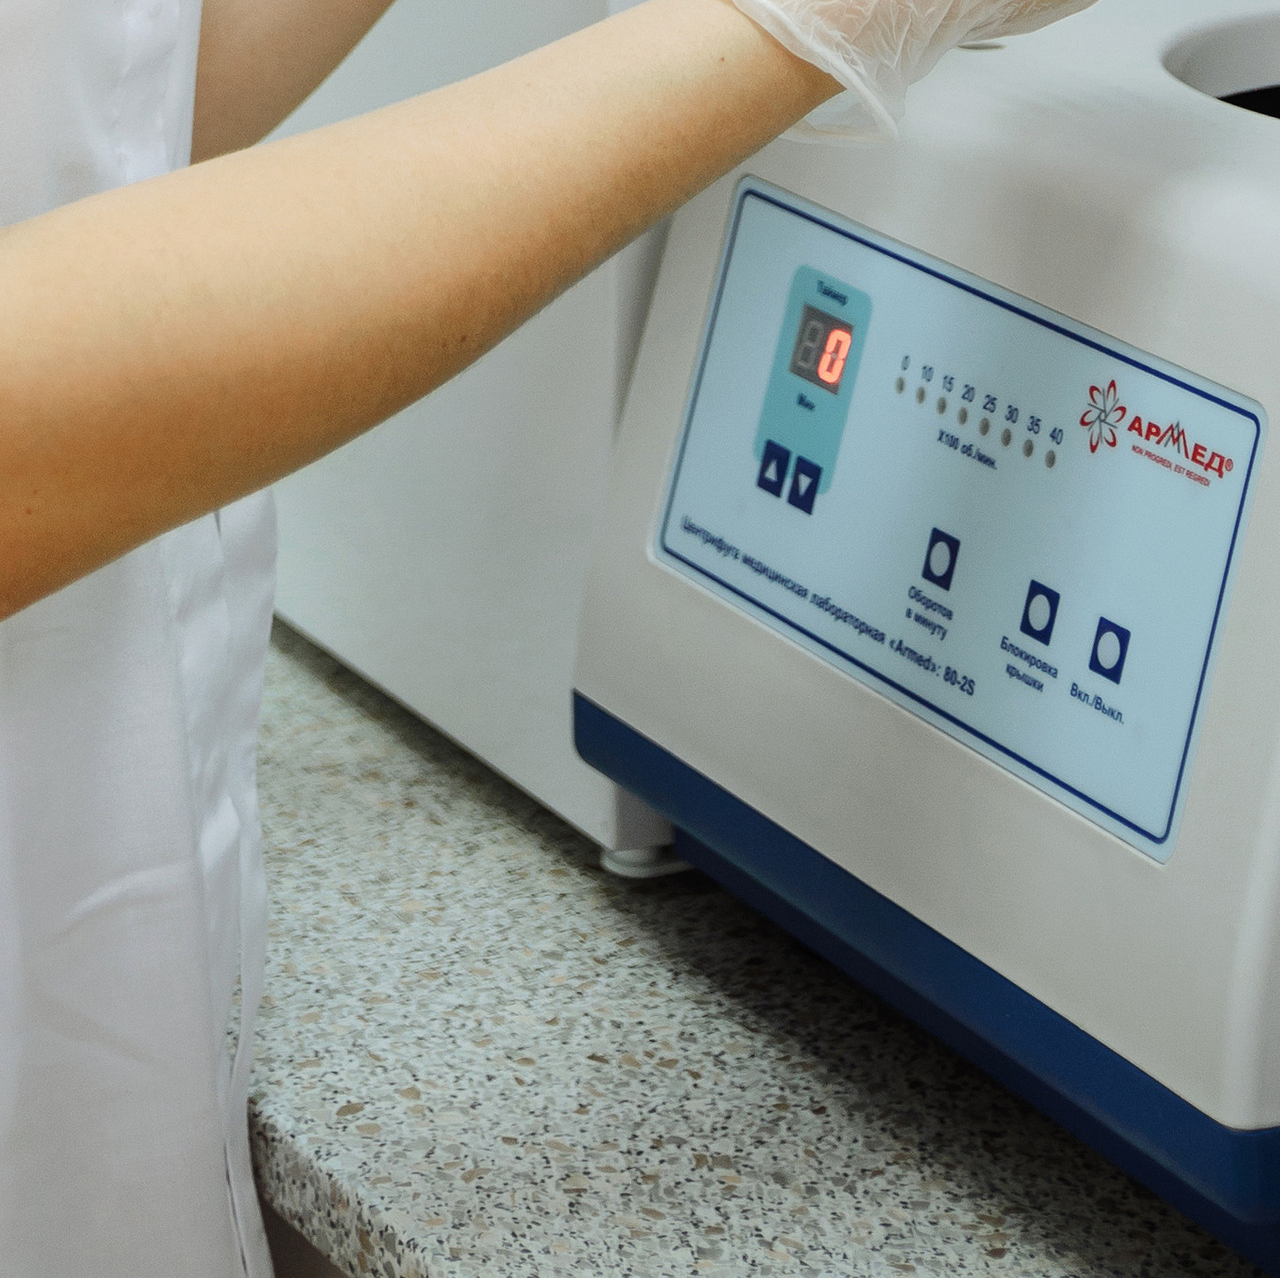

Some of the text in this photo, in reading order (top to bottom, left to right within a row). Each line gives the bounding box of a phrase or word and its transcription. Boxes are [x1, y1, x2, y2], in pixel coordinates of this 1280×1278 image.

[900, 355, 1064, 445] 0 10 15 20 25 30 35 40
[908, 585, 953, 621] Оборотов
[742, 553, 809, 598] медицинская
[810, 593, 886, 644] лабораторная
[943, 666, 976, 696] 80-2S
[905, 608, 948, 641] в минуту
[1000, 635, 1058, 679] Блокировка
[1005, 663, 1044, 693] крышки
[1070, 682, 1124, 724] Вкл./Выкл.
